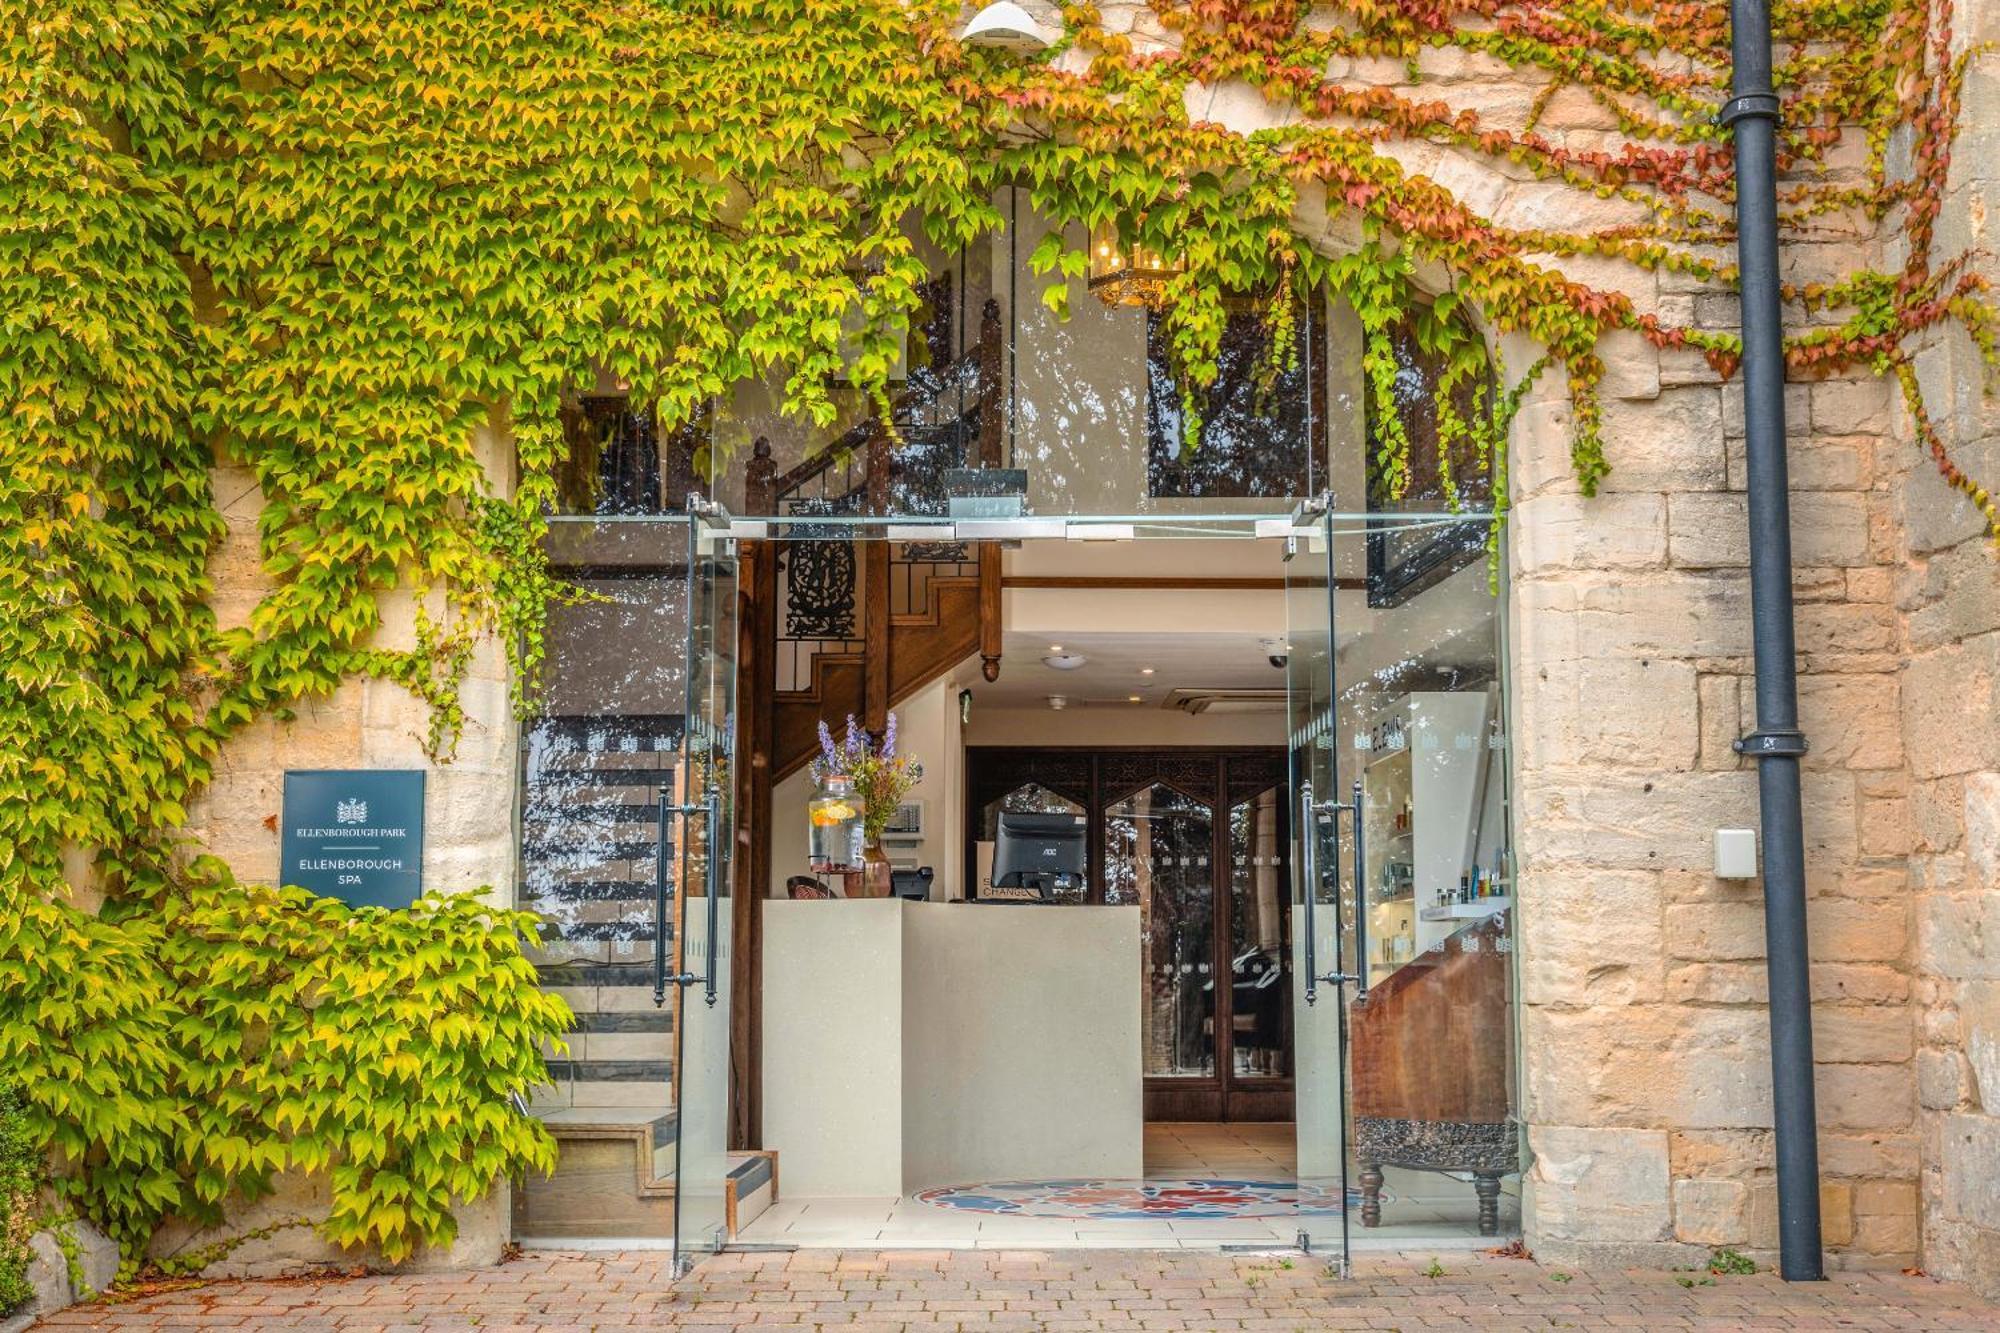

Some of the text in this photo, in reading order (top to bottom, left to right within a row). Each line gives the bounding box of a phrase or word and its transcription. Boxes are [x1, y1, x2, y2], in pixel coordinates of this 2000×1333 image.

[297, 828, 406, 837] ELLENBOROUGH PARK
[299, 859, 402, 870] ELLENBOROUGH
[337, 875, 362, 885] SPA
